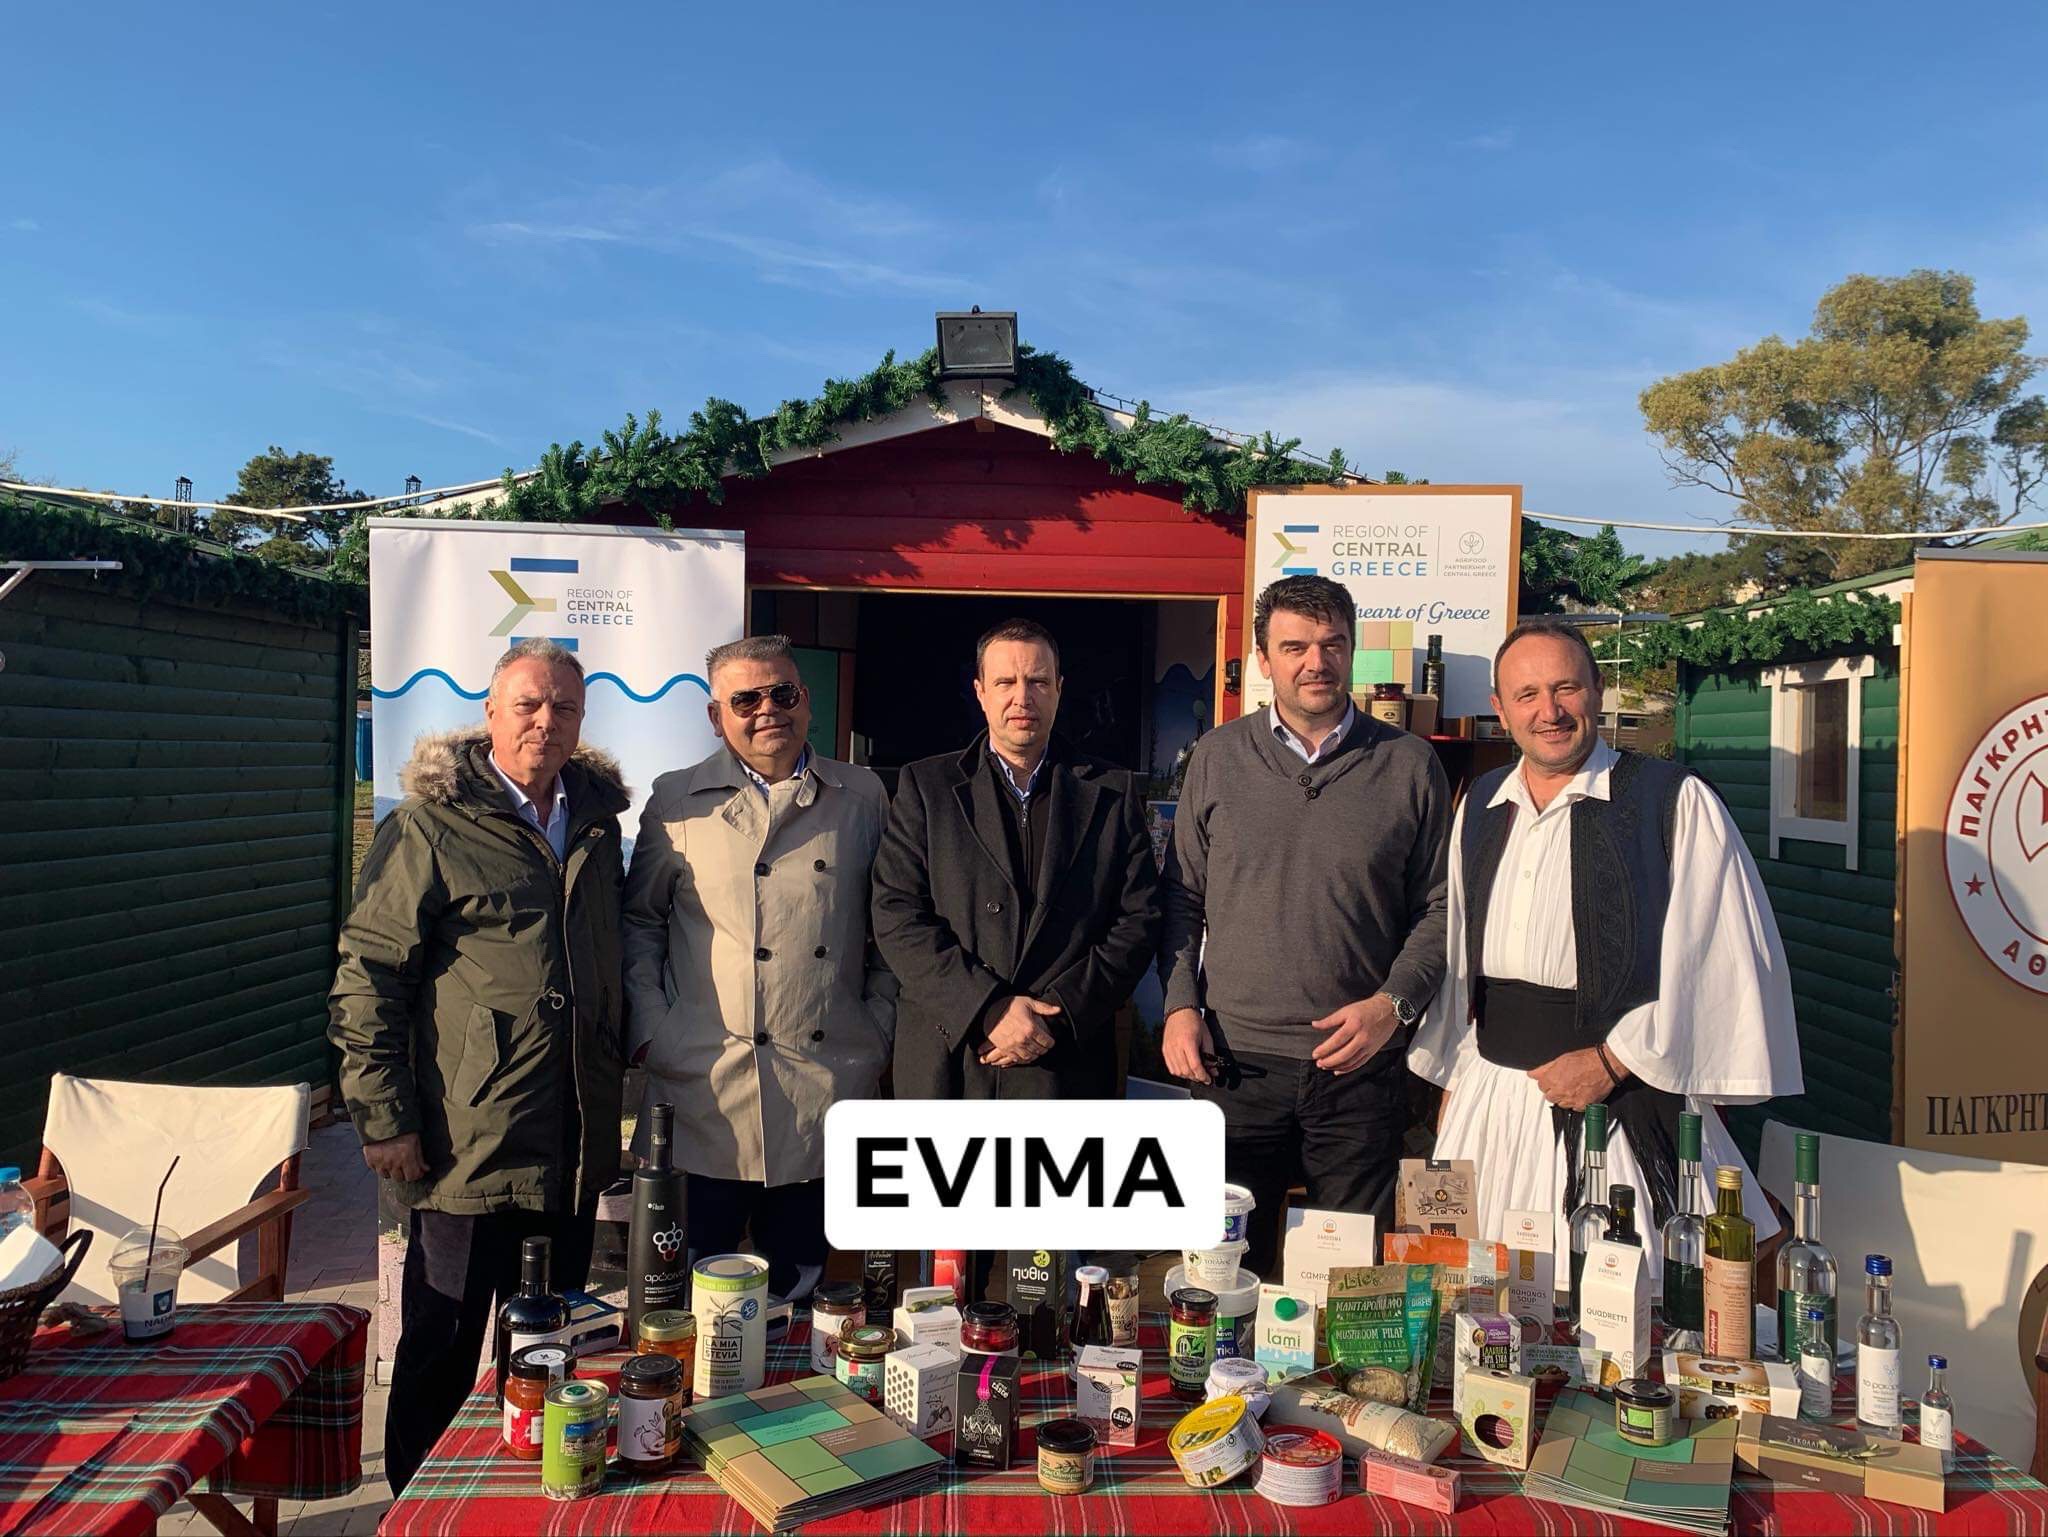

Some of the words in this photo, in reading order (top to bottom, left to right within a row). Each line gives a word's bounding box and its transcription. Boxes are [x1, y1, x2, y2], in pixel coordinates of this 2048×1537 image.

[1333, 525, 1398, 538] REGION
[1404, 525, 1429, 538] OF
[1332, 542, 1428, 557] CENTRAL
[1332, 561, 1427, 577] GREECE
[567, 588, 613, 600] REGION
[616, 590, 633, 600] OF
[567, 600, 633, 612] CENTRAL
[567, 613, 634, 626] GREECE
[1405, 603, 1425, 621] of
[1427, 601, 1490, 625] Greece
[1959, 707, 2048, 837] ΠΑΓΚΡΗ
[1336, 1328, 1379, 1340] MUSHROOM
[1382, 1327, 1405, 1339] PILAF
[705, 1340, 717, 1348] LA
[719, 1340, 738, 1348] MIA
[705, 1350, 738, 1359] STEVIA
